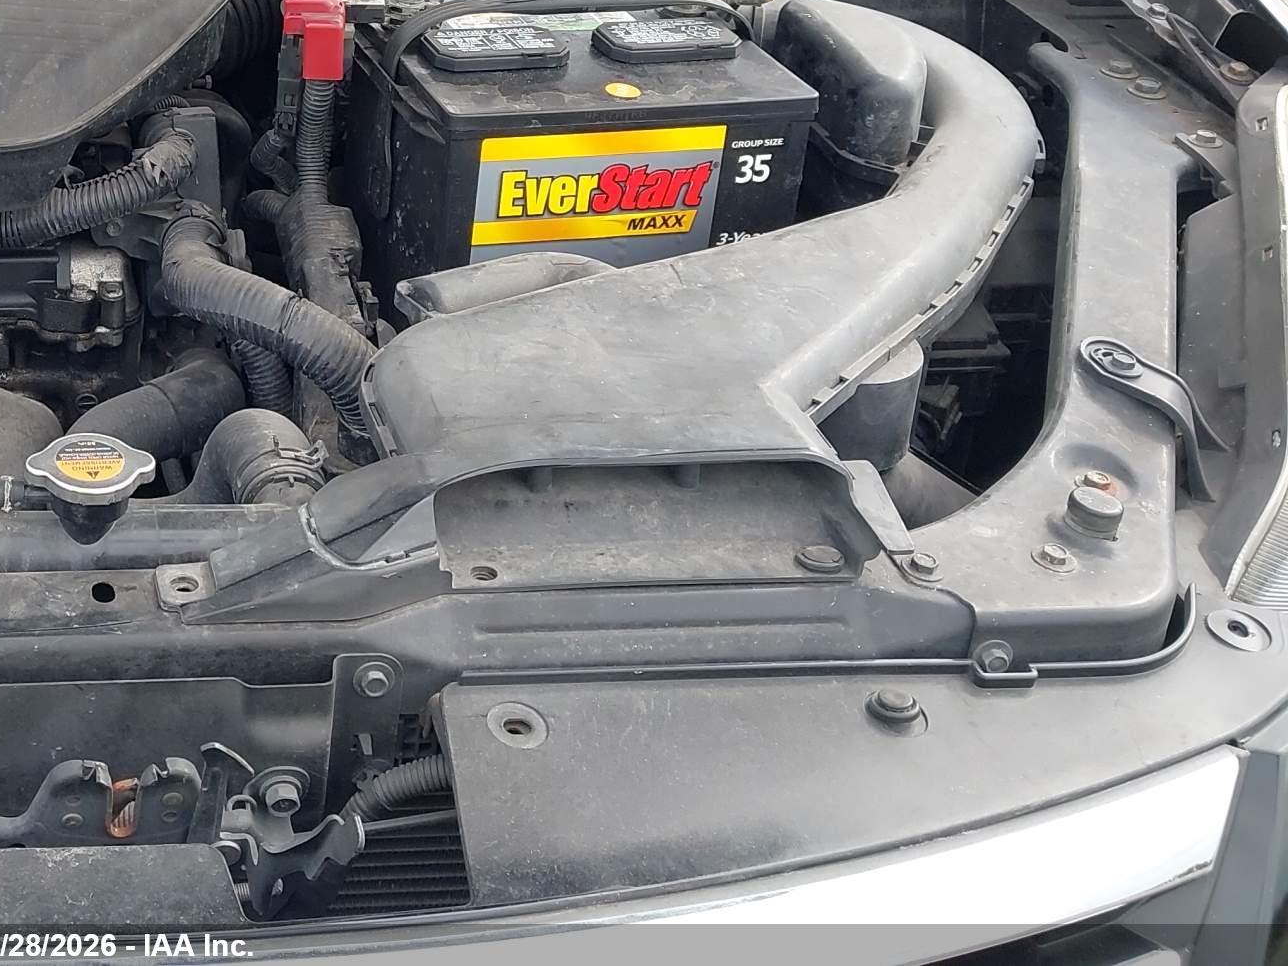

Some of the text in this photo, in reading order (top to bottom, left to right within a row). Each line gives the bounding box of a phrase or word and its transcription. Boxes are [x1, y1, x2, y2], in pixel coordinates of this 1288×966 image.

[732, 138, 784, 149] GROUP SIZE
[735, 153, 773, 184] 35
[498, 160, 713, 218] EverStart
[627, 214, 687, 232] MAXX
